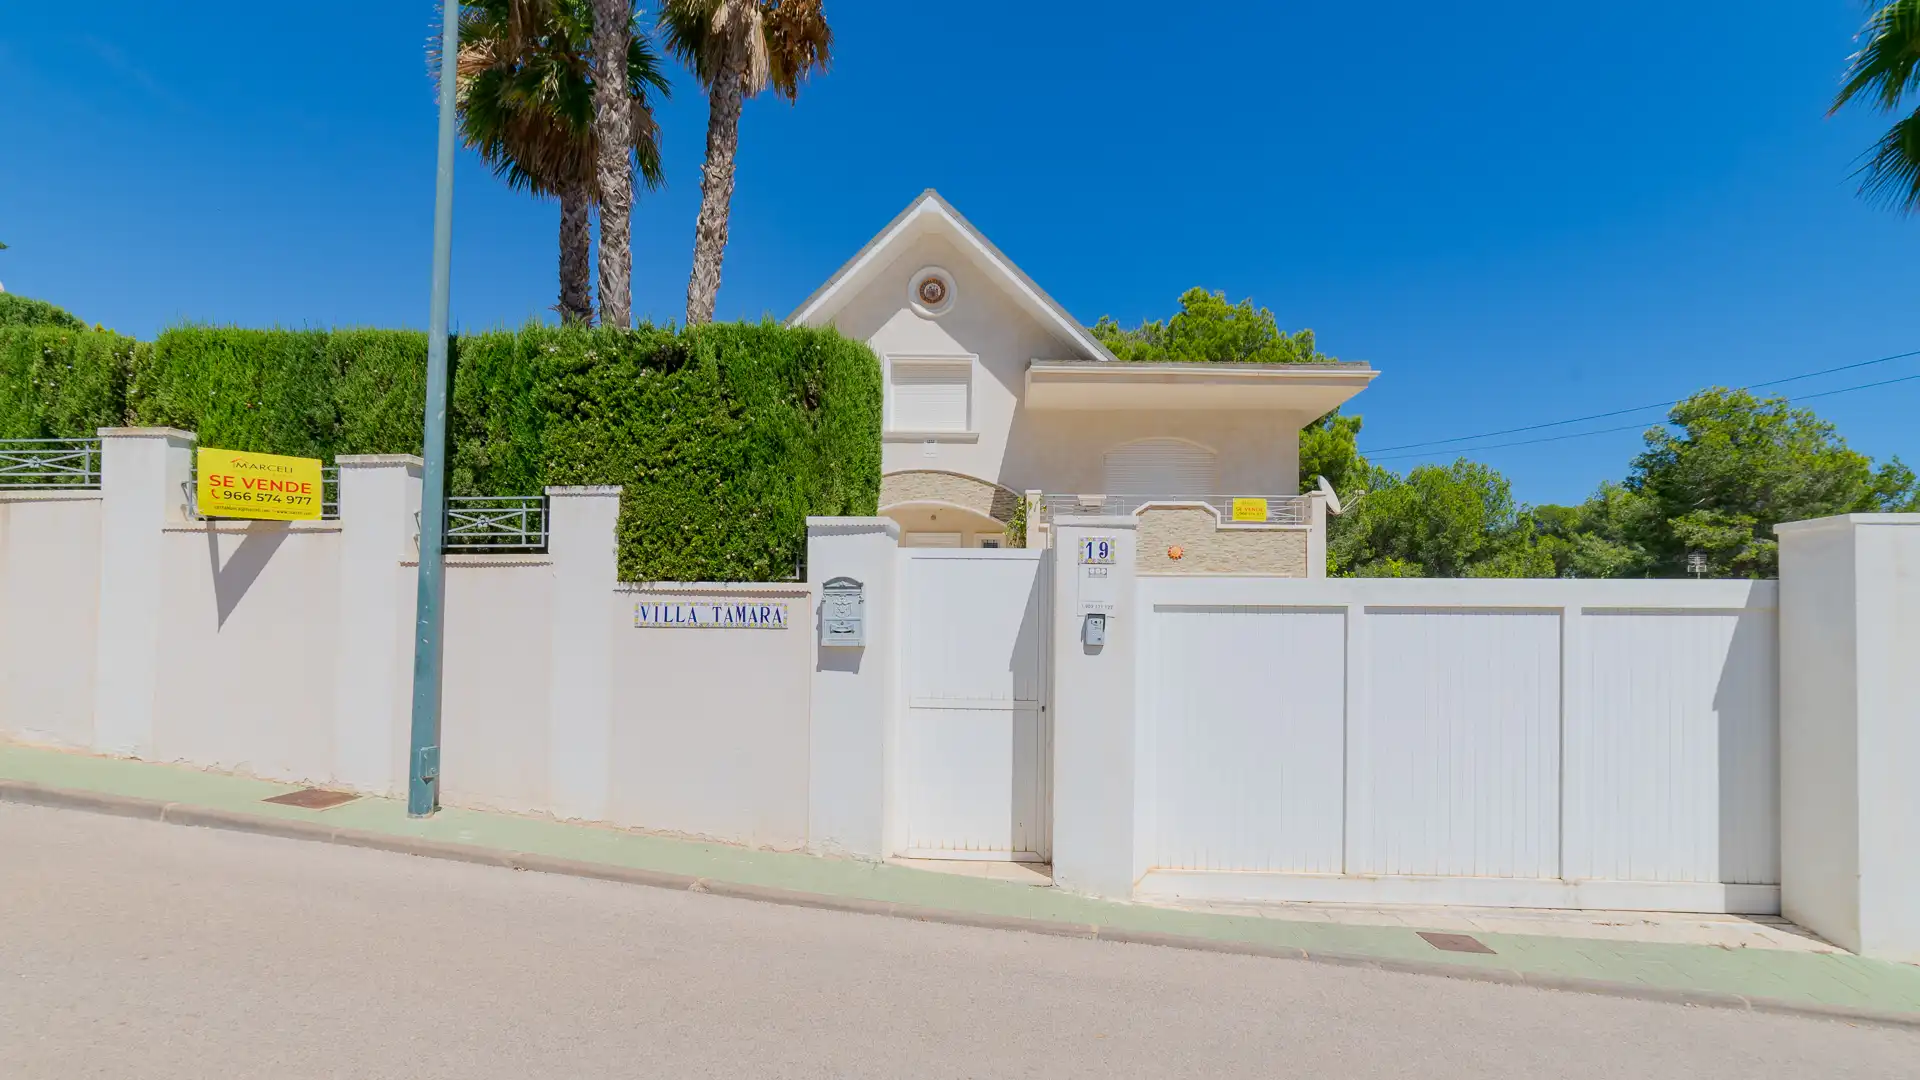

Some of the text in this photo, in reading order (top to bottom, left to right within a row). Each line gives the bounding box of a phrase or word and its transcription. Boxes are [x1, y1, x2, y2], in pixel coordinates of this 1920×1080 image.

[209, 474, 312, 494] SE VENDE
[223, 490, 312, 505] 966 574 977
[1085, 541, 1109, 559] 19
[640, 605, 782, 623] VILLA TAMARA
